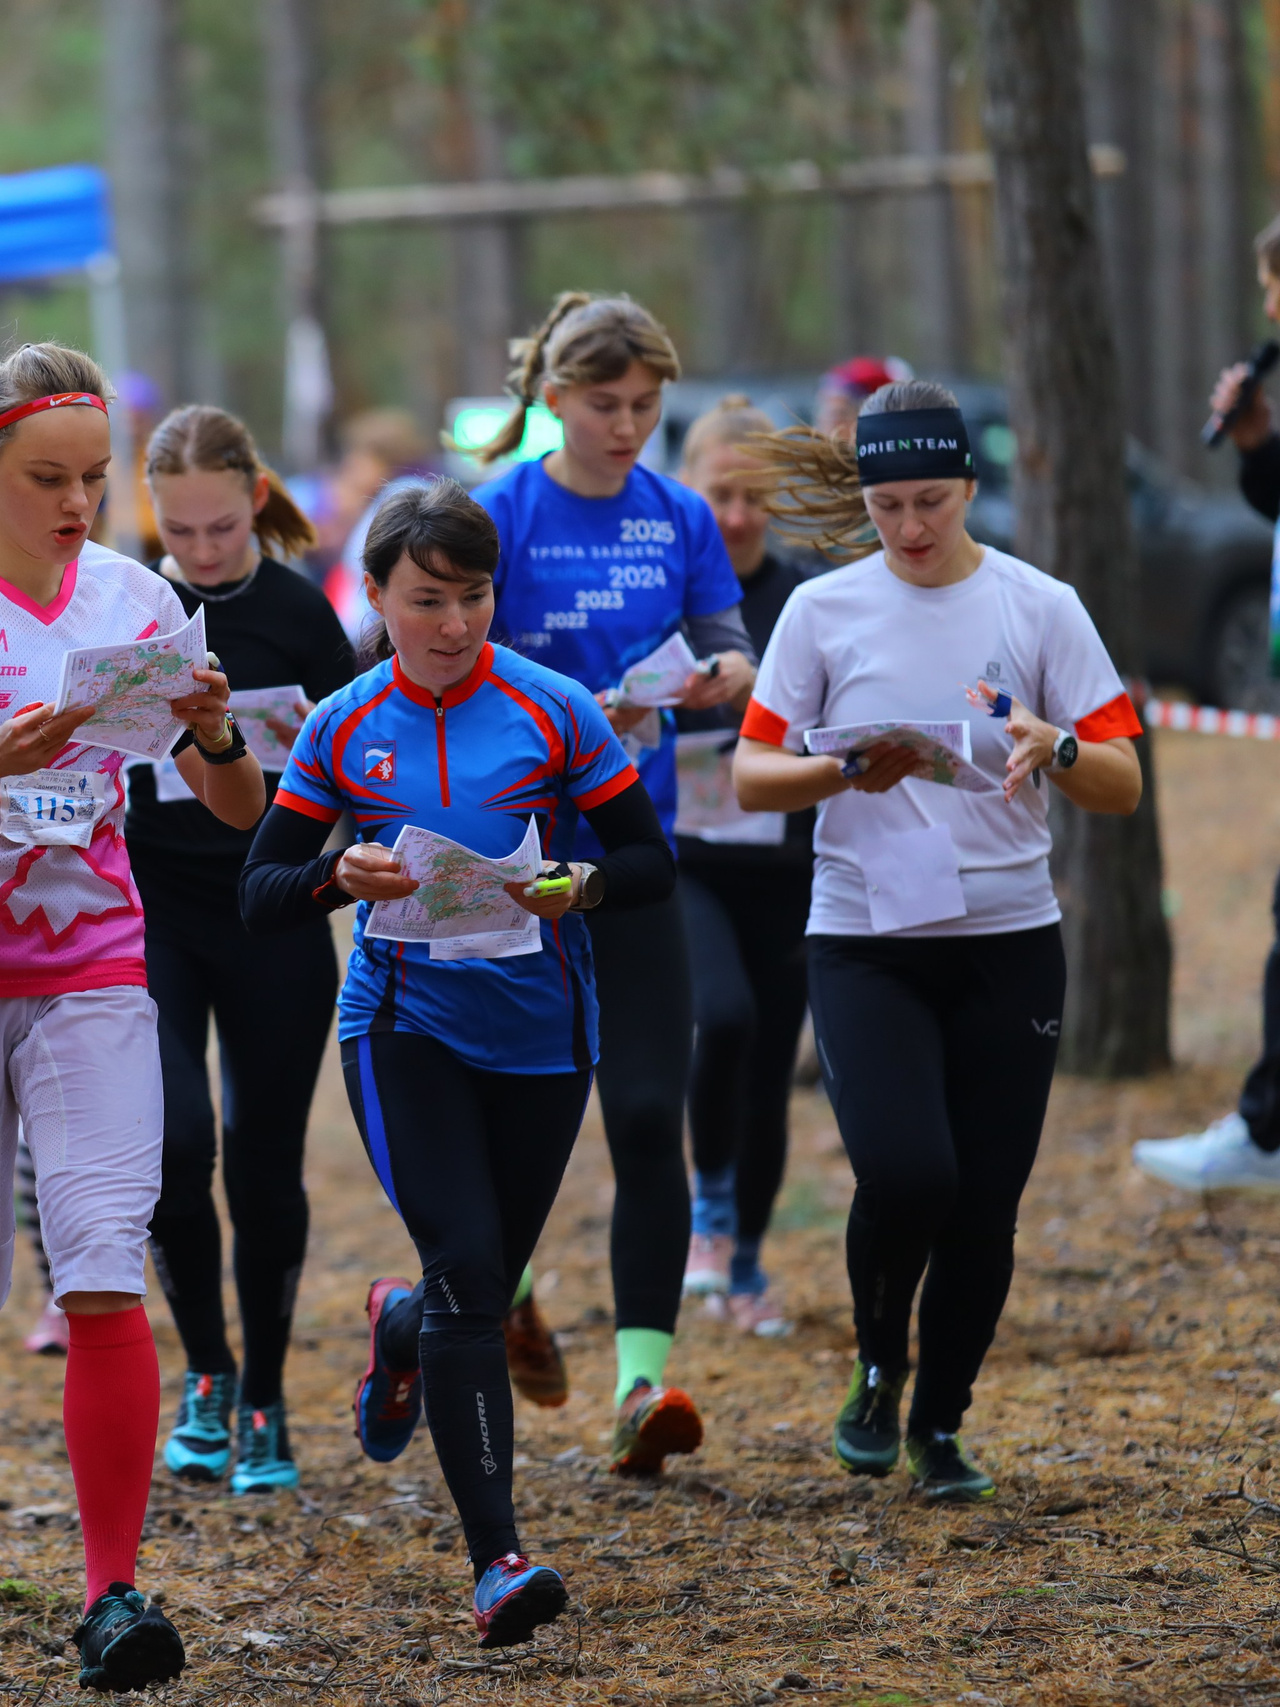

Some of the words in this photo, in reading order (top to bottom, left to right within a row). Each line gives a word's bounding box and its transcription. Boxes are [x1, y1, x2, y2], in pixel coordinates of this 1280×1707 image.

[859, 438, 958, 458] ORIENTEAM
[621, 518, 676, 544] 2025
[529, 545, 586, 560] ТРОПА
[591, 543, 665, 560] ЗАЙЦЕВА
[608, 565, 667, 589] 2024
[575, 590, 625, 610] 2023
[543, 611, 589, 630] 2022
[34, 795, 76, 822] 115
[476, 1391, 492, 1453] NORD
